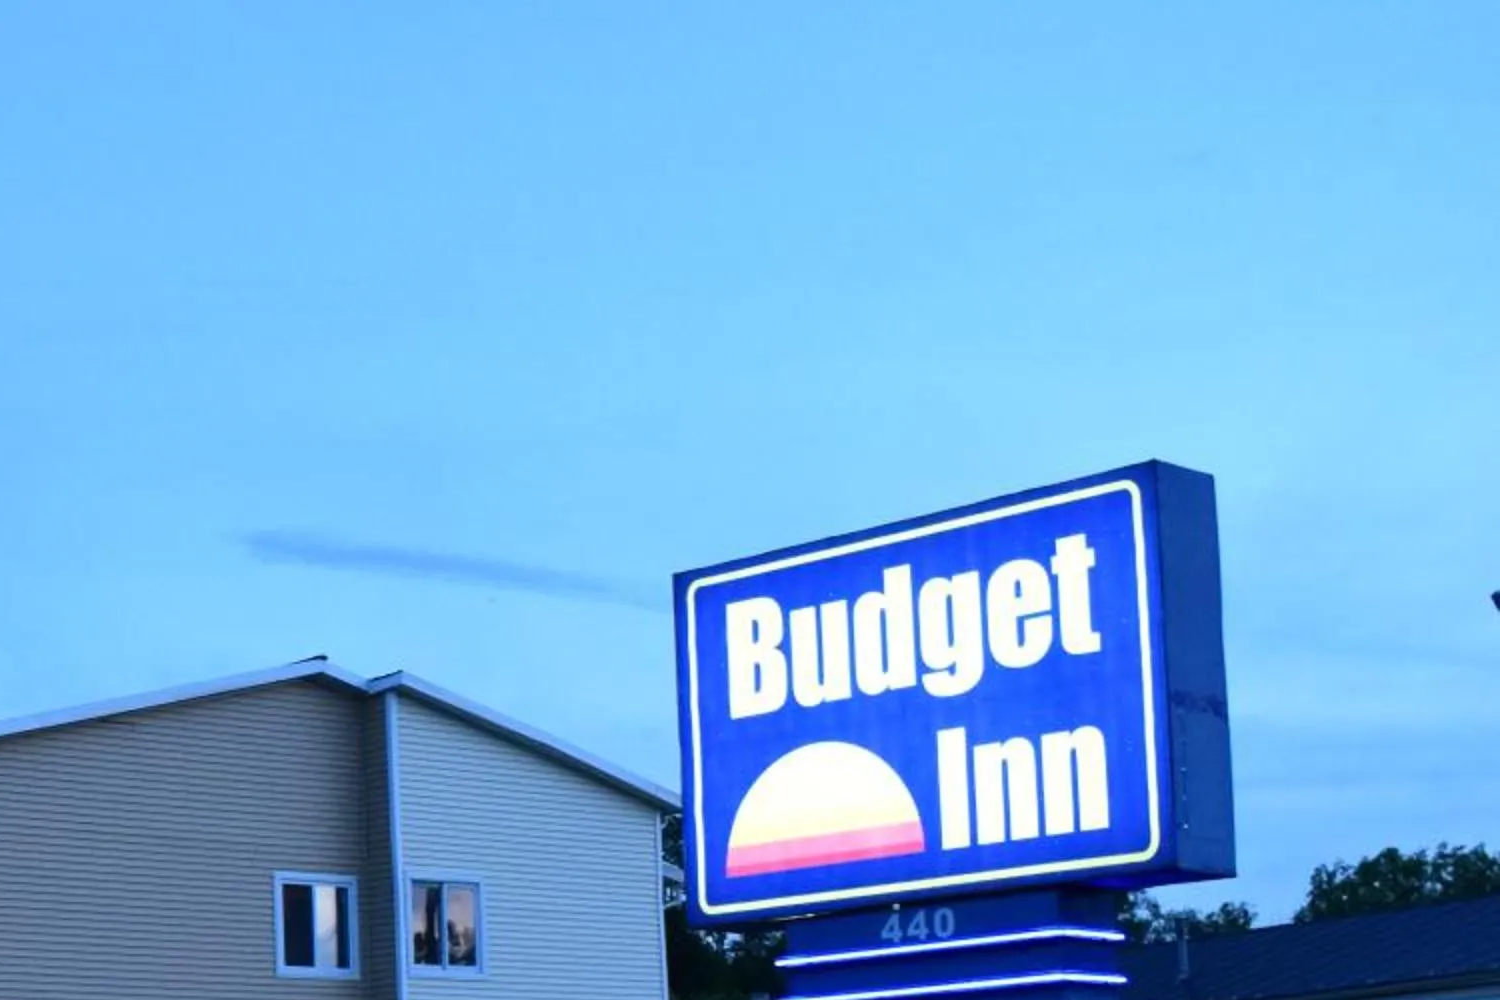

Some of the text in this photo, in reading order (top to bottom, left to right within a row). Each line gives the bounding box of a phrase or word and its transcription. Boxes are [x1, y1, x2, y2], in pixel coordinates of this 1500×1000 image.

[725, 533, 1101, 720] Budget
[936, 725, 1110, 851] Inn
[881, 907, 955, 943] 440
